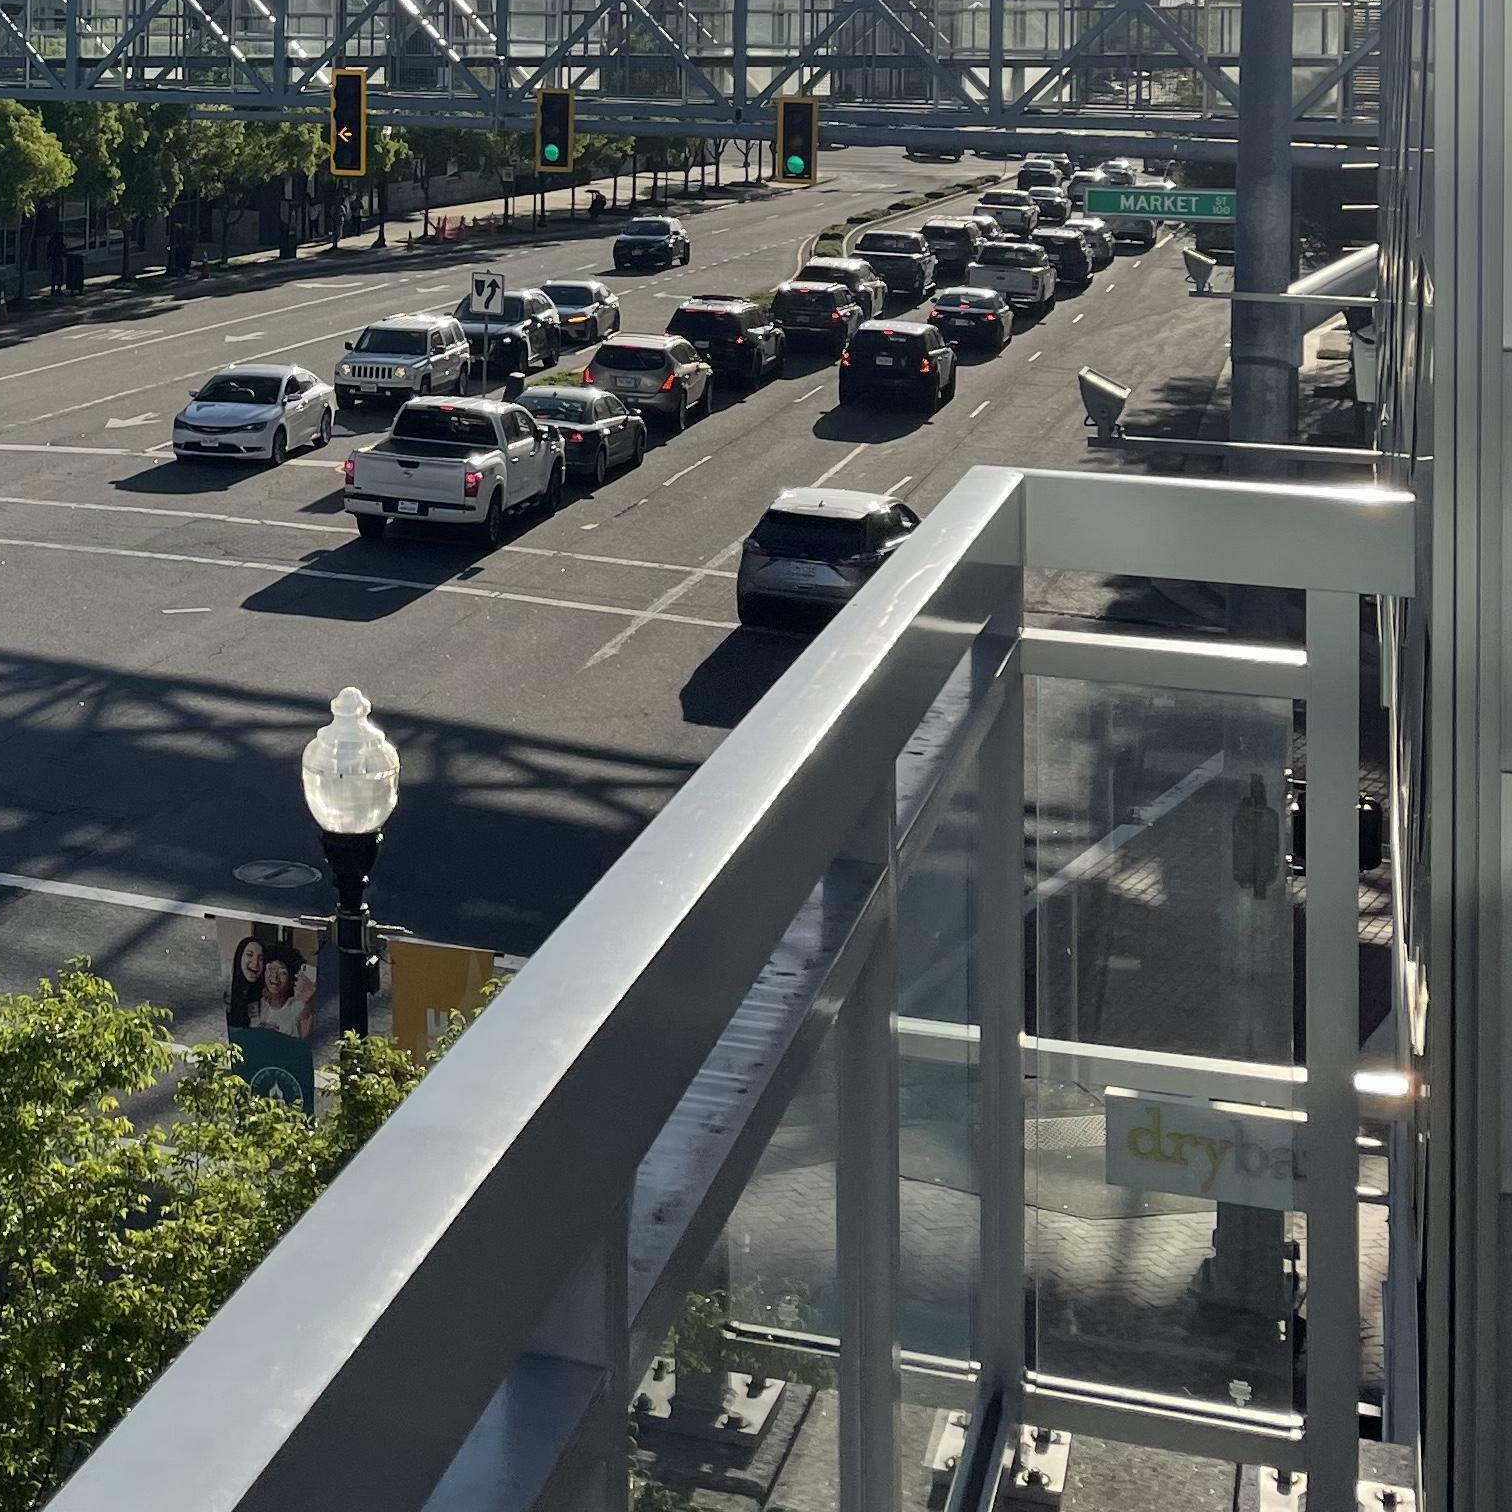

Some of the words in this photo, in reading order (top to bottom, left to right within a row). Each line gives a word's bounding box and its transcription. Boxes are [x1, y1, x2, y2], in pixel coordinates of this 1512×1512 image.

[1119, 194, 1199, 213] MARKET
[1215, 196, 1227, 206] ST
[1127, 1106, 1307, 1193] dryba
